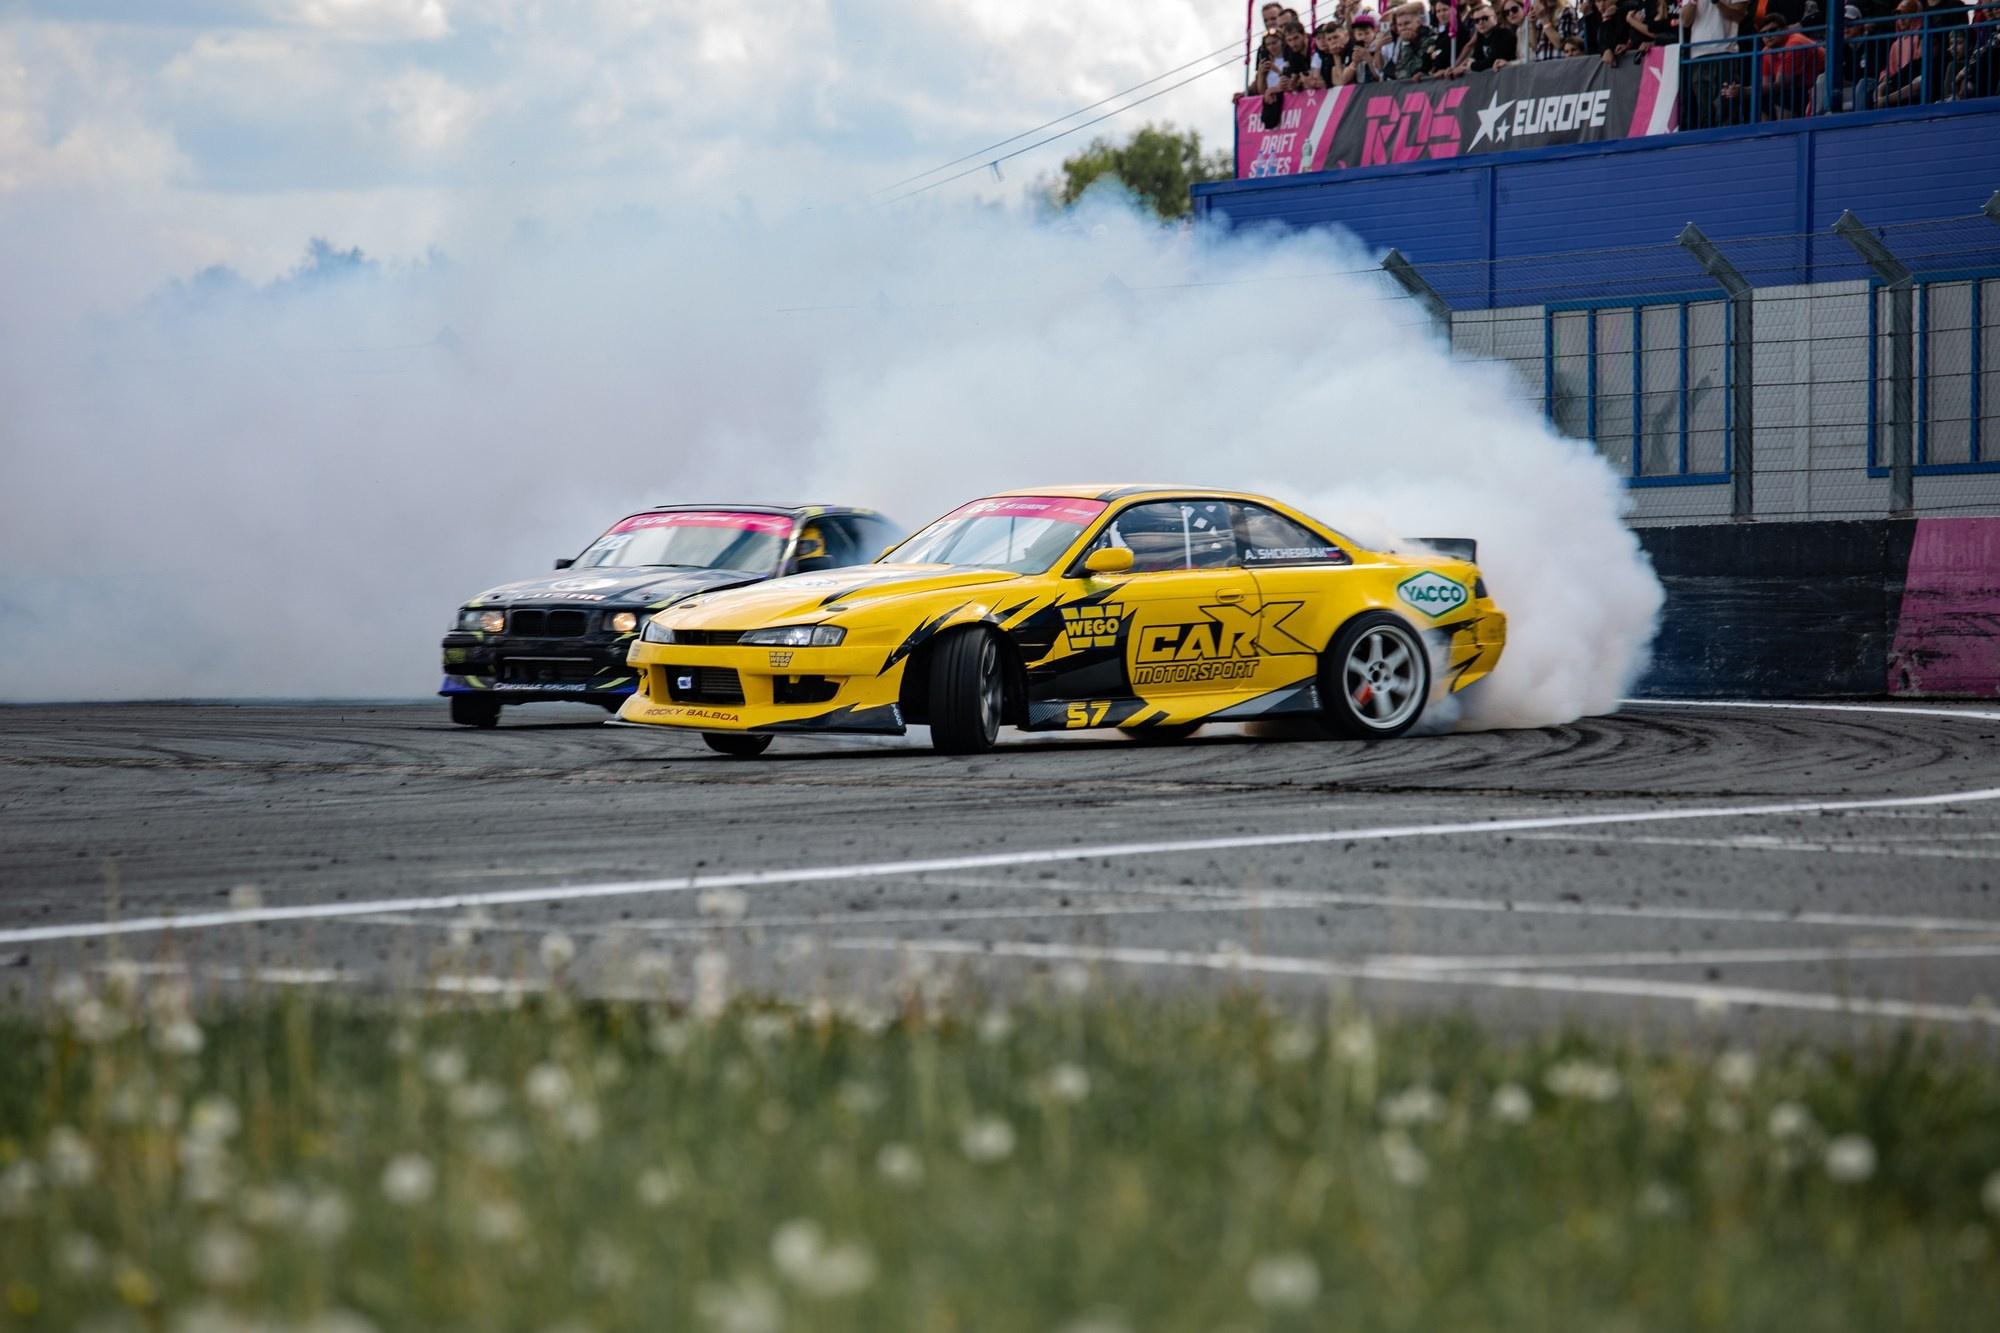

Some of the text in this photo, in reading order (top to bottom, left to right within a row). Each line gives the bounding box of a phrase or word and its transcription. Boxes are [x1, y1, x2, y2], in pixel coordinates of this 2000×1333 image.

[1247, 108, 1302, 133] RUIAN
[1360, 86, 1611, 167] RDS EUROPE
[1260, 132, 1297, 155] DRIFT
[1248, 156, 1292, 178] SES
[1244, 547, 1328, 560] A. SHCHERBAK
[1404, 585, 1462, 602] YACCO
[1065, 617, 1120, 637] WEGO
[770, 656, 792, 664] WEGO
[1133, 660, 1260, 685] MOTORSPORT
[645, 708, 739, 722] ROCKY BALBOA
[890, 703, 903, 726] YACCO
[1066, 700, 1112, 728] 57
